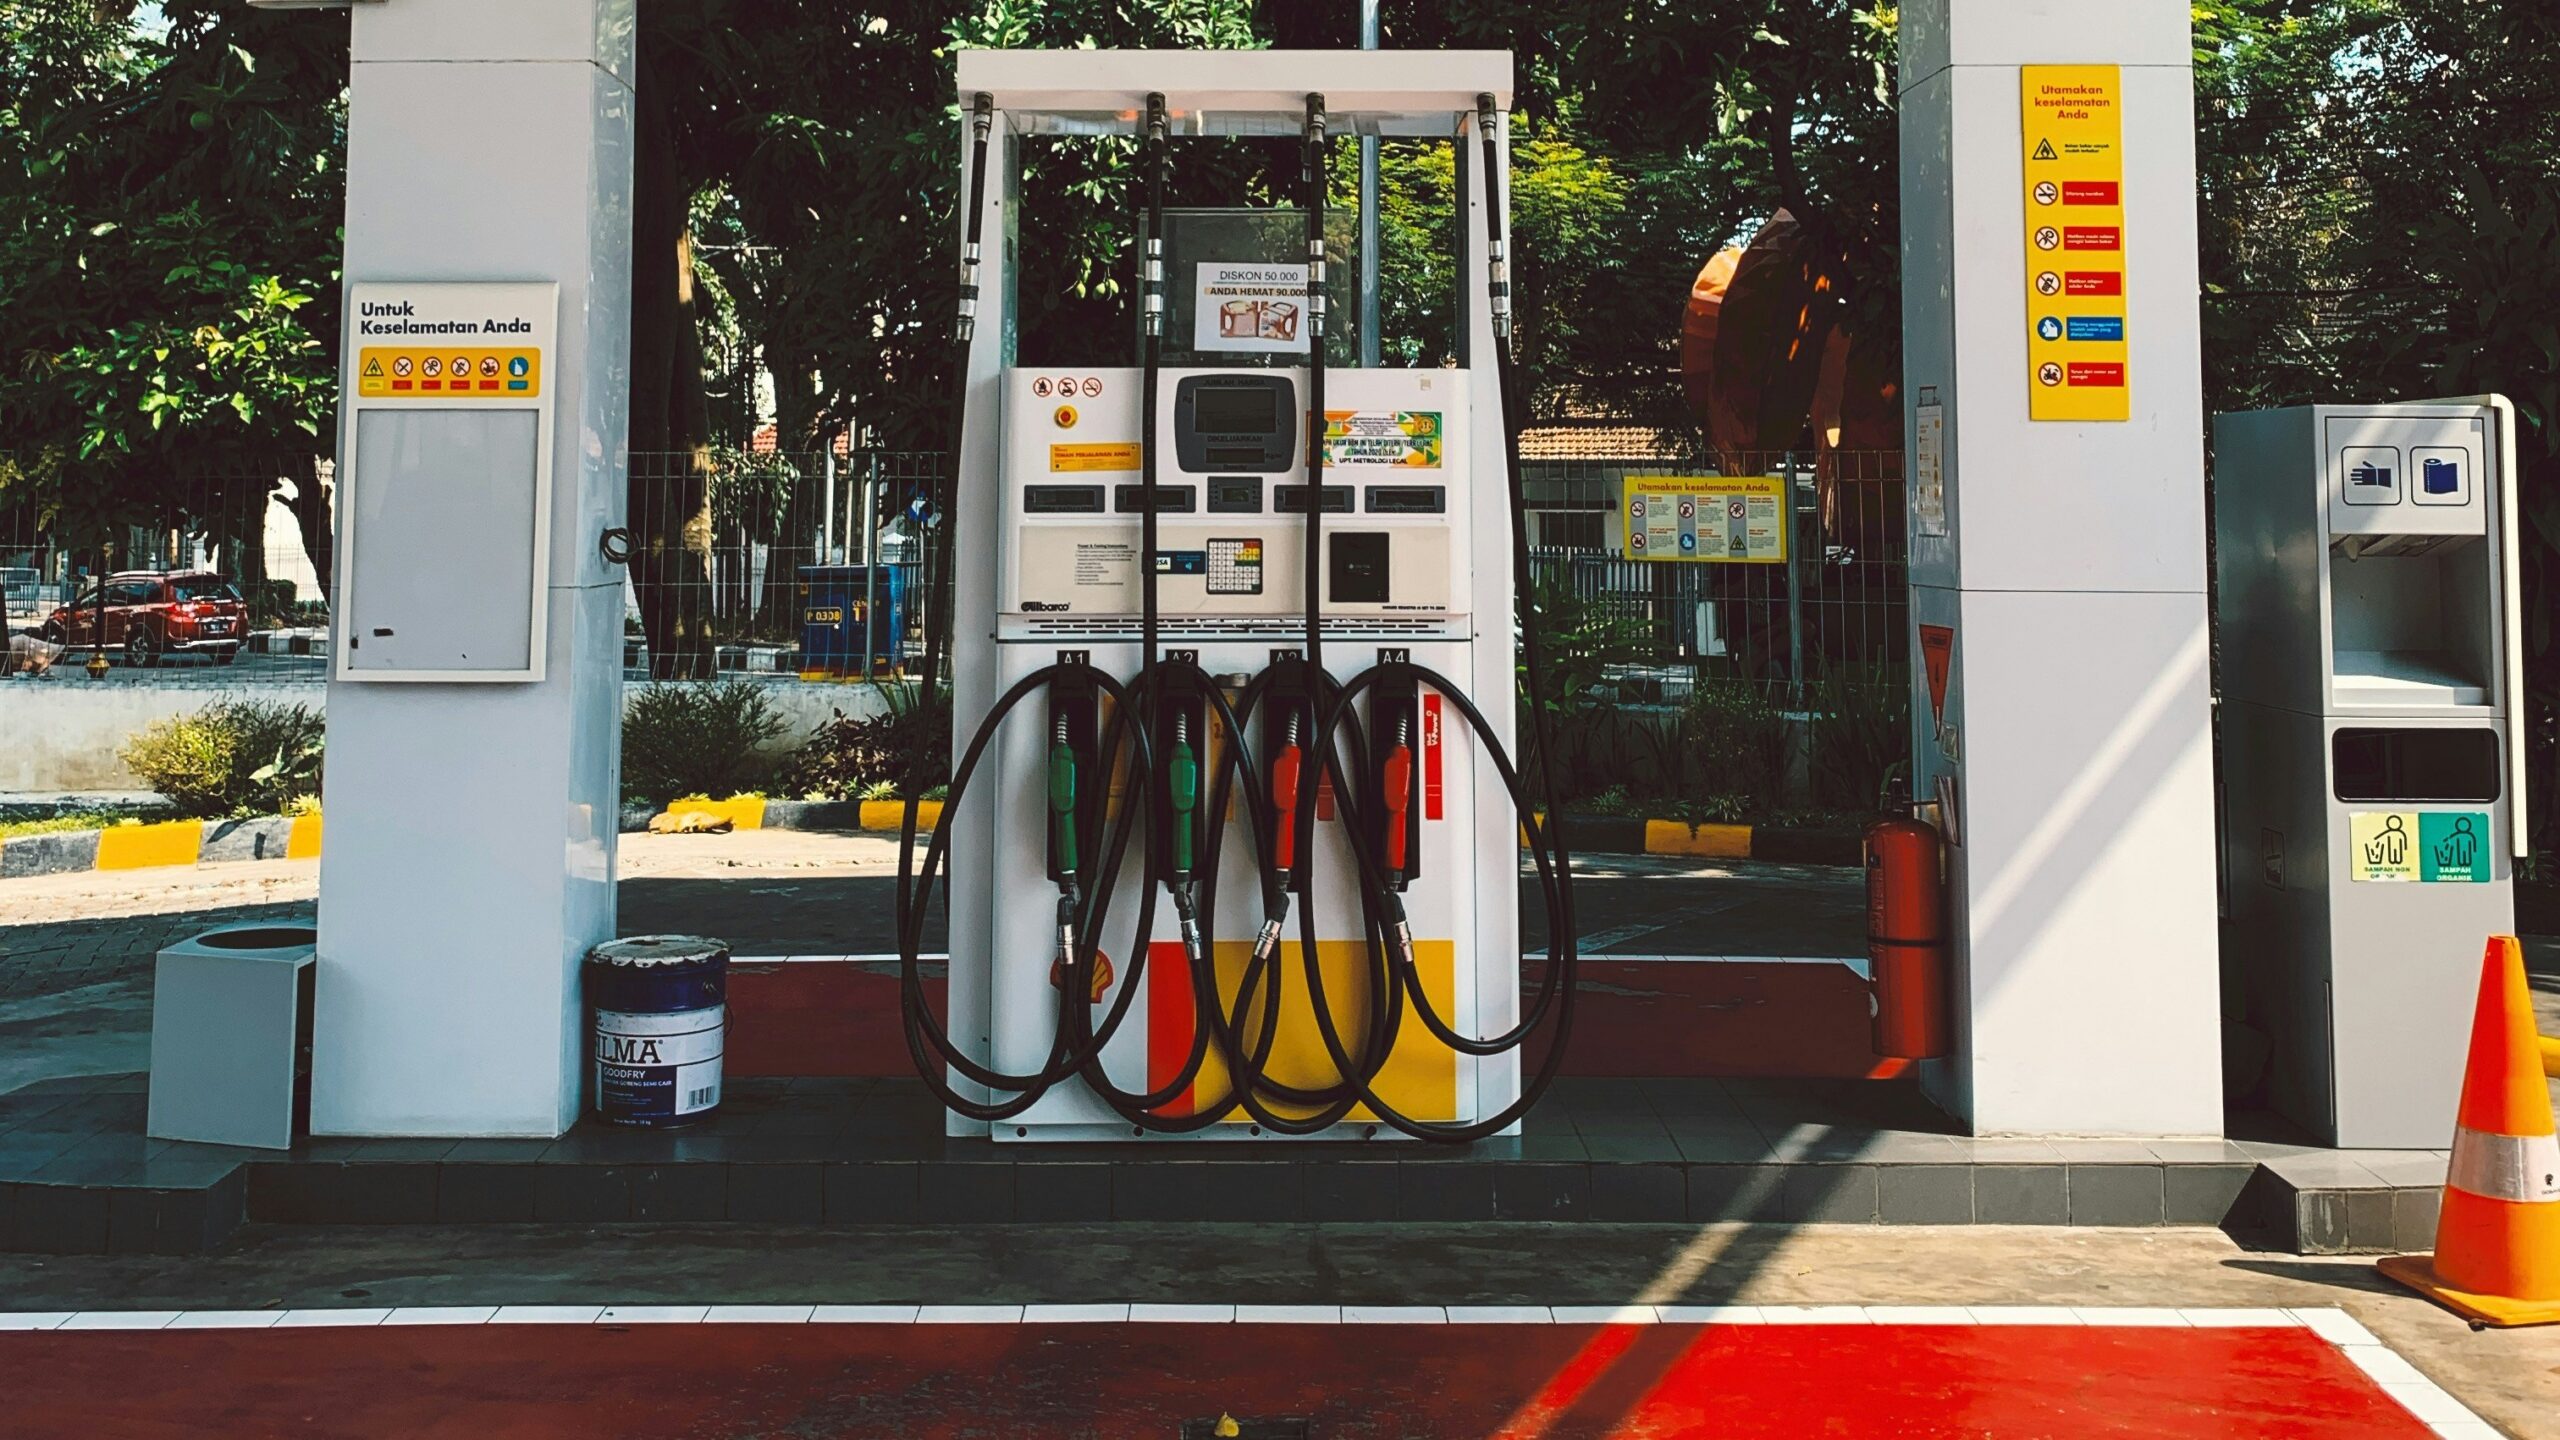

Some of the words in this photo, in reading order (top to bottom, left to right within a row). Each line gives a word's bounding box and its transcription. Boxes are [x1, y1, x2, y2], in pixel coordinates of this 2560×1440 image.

[2041, 84, 2103, 94] Utamakan
[2034, 97, 2110, 107] keselamatan
[2057, 110, 2088, 119] Anda
[1220, 271, 1261, 280] DISKON
[1264, 271, 1298, 281] 50.000
[1210, 287, 1238, 296] ANDA
[1240, 287, 1274, 296] HEMAT
[1276, 288, 1307, 297] 90.000
[361, 301, 414, 316] Untuk
[360, 319, 478, 334] Keselamatan
[483, 317, 531, 333] Anda
[1637, 483, 1681, 492] Utamakan
[1685, 483, 1742, 492] keselamatan
[1745, 483, 1770, 492] Anda
[603, 1067, 645, 1079] GOODFRY
